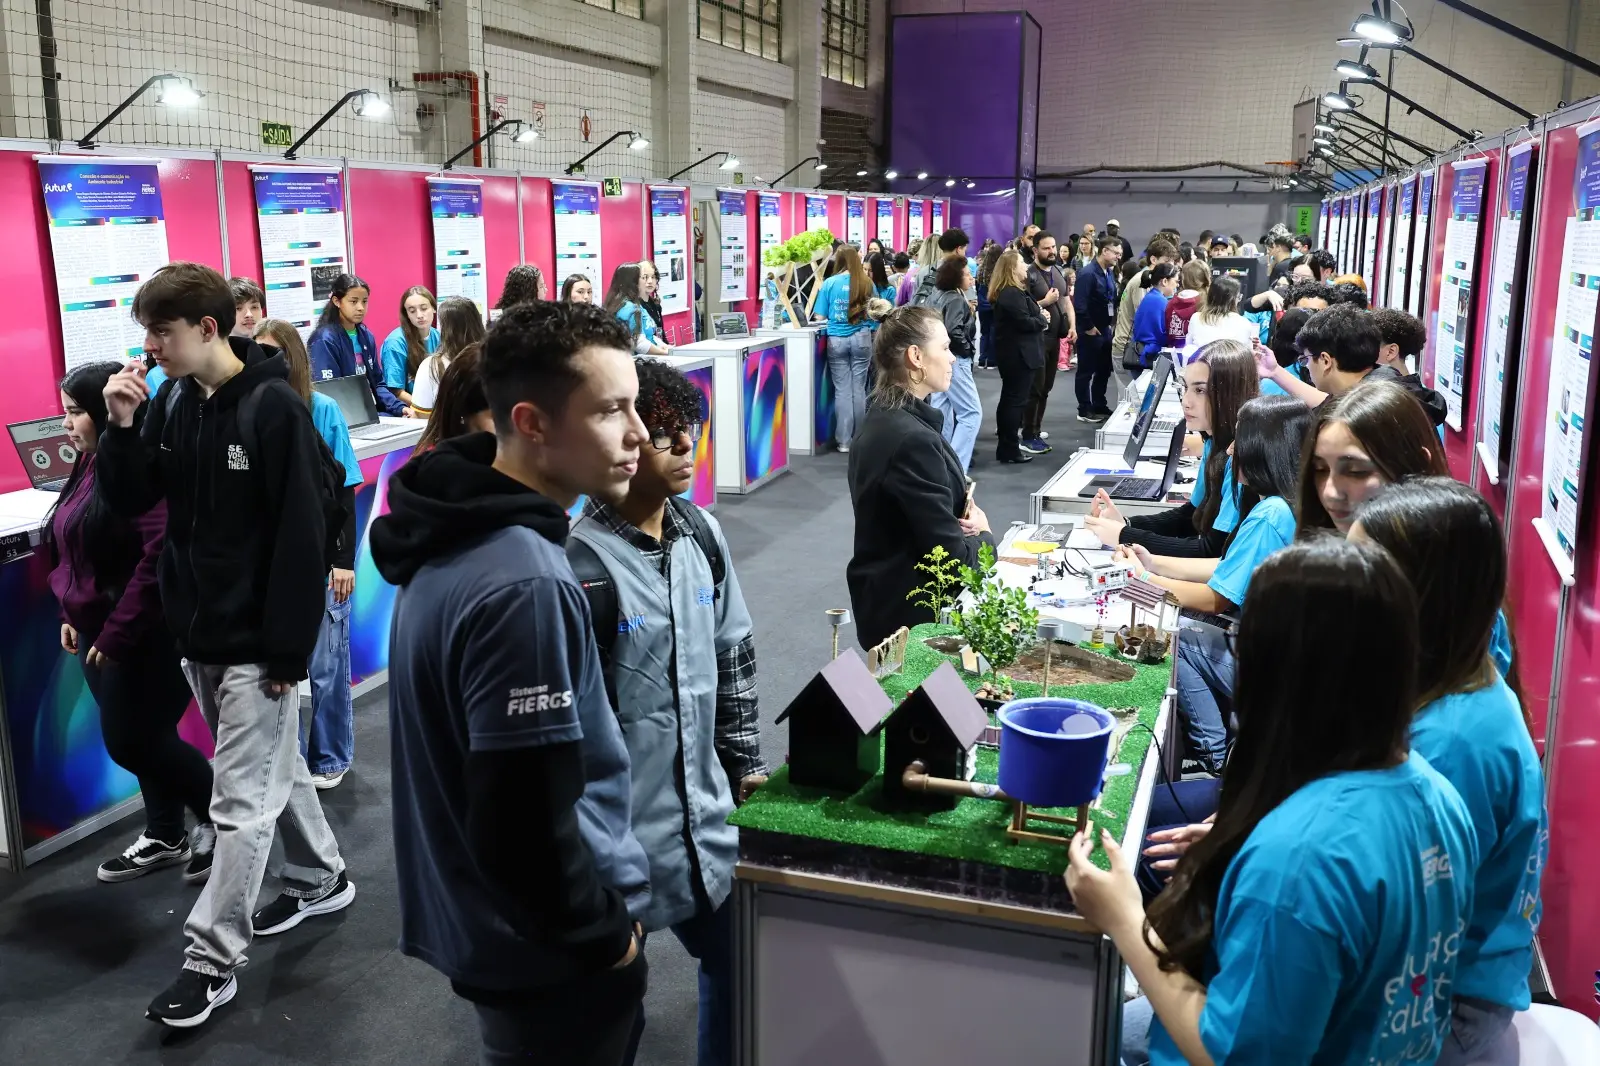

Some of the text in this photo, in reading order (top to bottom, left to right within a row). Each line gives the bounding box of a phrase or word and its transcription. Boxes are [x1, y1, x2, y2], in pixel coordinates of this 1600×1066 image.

[228, 460, 249, 470] THERE
[6, 549, 17, 557] 53
[509, 684, 548, 697] Sistema
